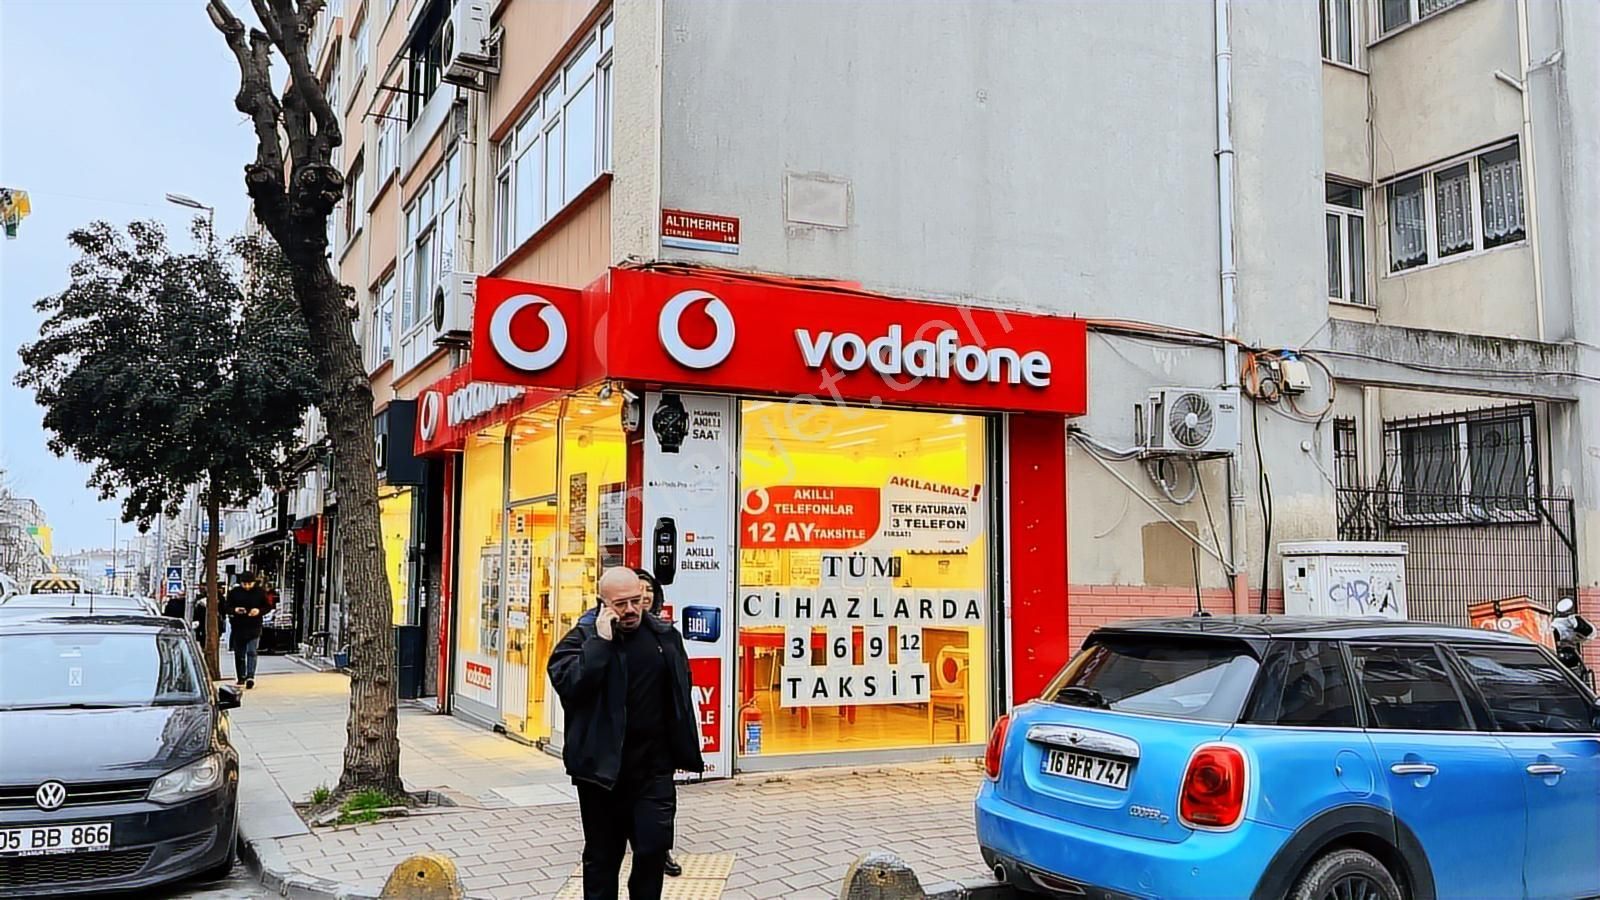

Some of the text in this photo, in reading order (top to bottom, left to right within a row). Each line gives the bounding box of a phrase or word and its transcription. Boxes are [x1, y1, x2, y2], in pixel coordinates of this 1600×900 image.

[666, 215, 734, 233] ALTIMERMER
[795, 324, 1051, 387] vodafone
[692, 429, 720, 440] SAAT
[793, 489, 834, 500] AKILLI
[773, 503, 854, 515] TELEFONLAR
[892, 504, 967, 515] TEK FATURAYA
[747, 522, 866, 542] 12 AY TAKSİTLE
[892, 518, 966, 529] 3 TELEFON
[685, 547, 714, 557] AKILLI
[681, 558, 720, 570] BİLEKLİK
[823, 552, 894, 578] TÜM
[743, 592, 980, 619] CİHAZLARDA
[688, 617, 710, 634] JBL
[791, 634, 920, 658] 3 6 9 12
[787, 670, 925, 699] TAKSİT
[1050, 751, 1127, 785] 16 BFR 747
[32, 828, 62, 848] BB
[72, 826, 109, 845] 866
